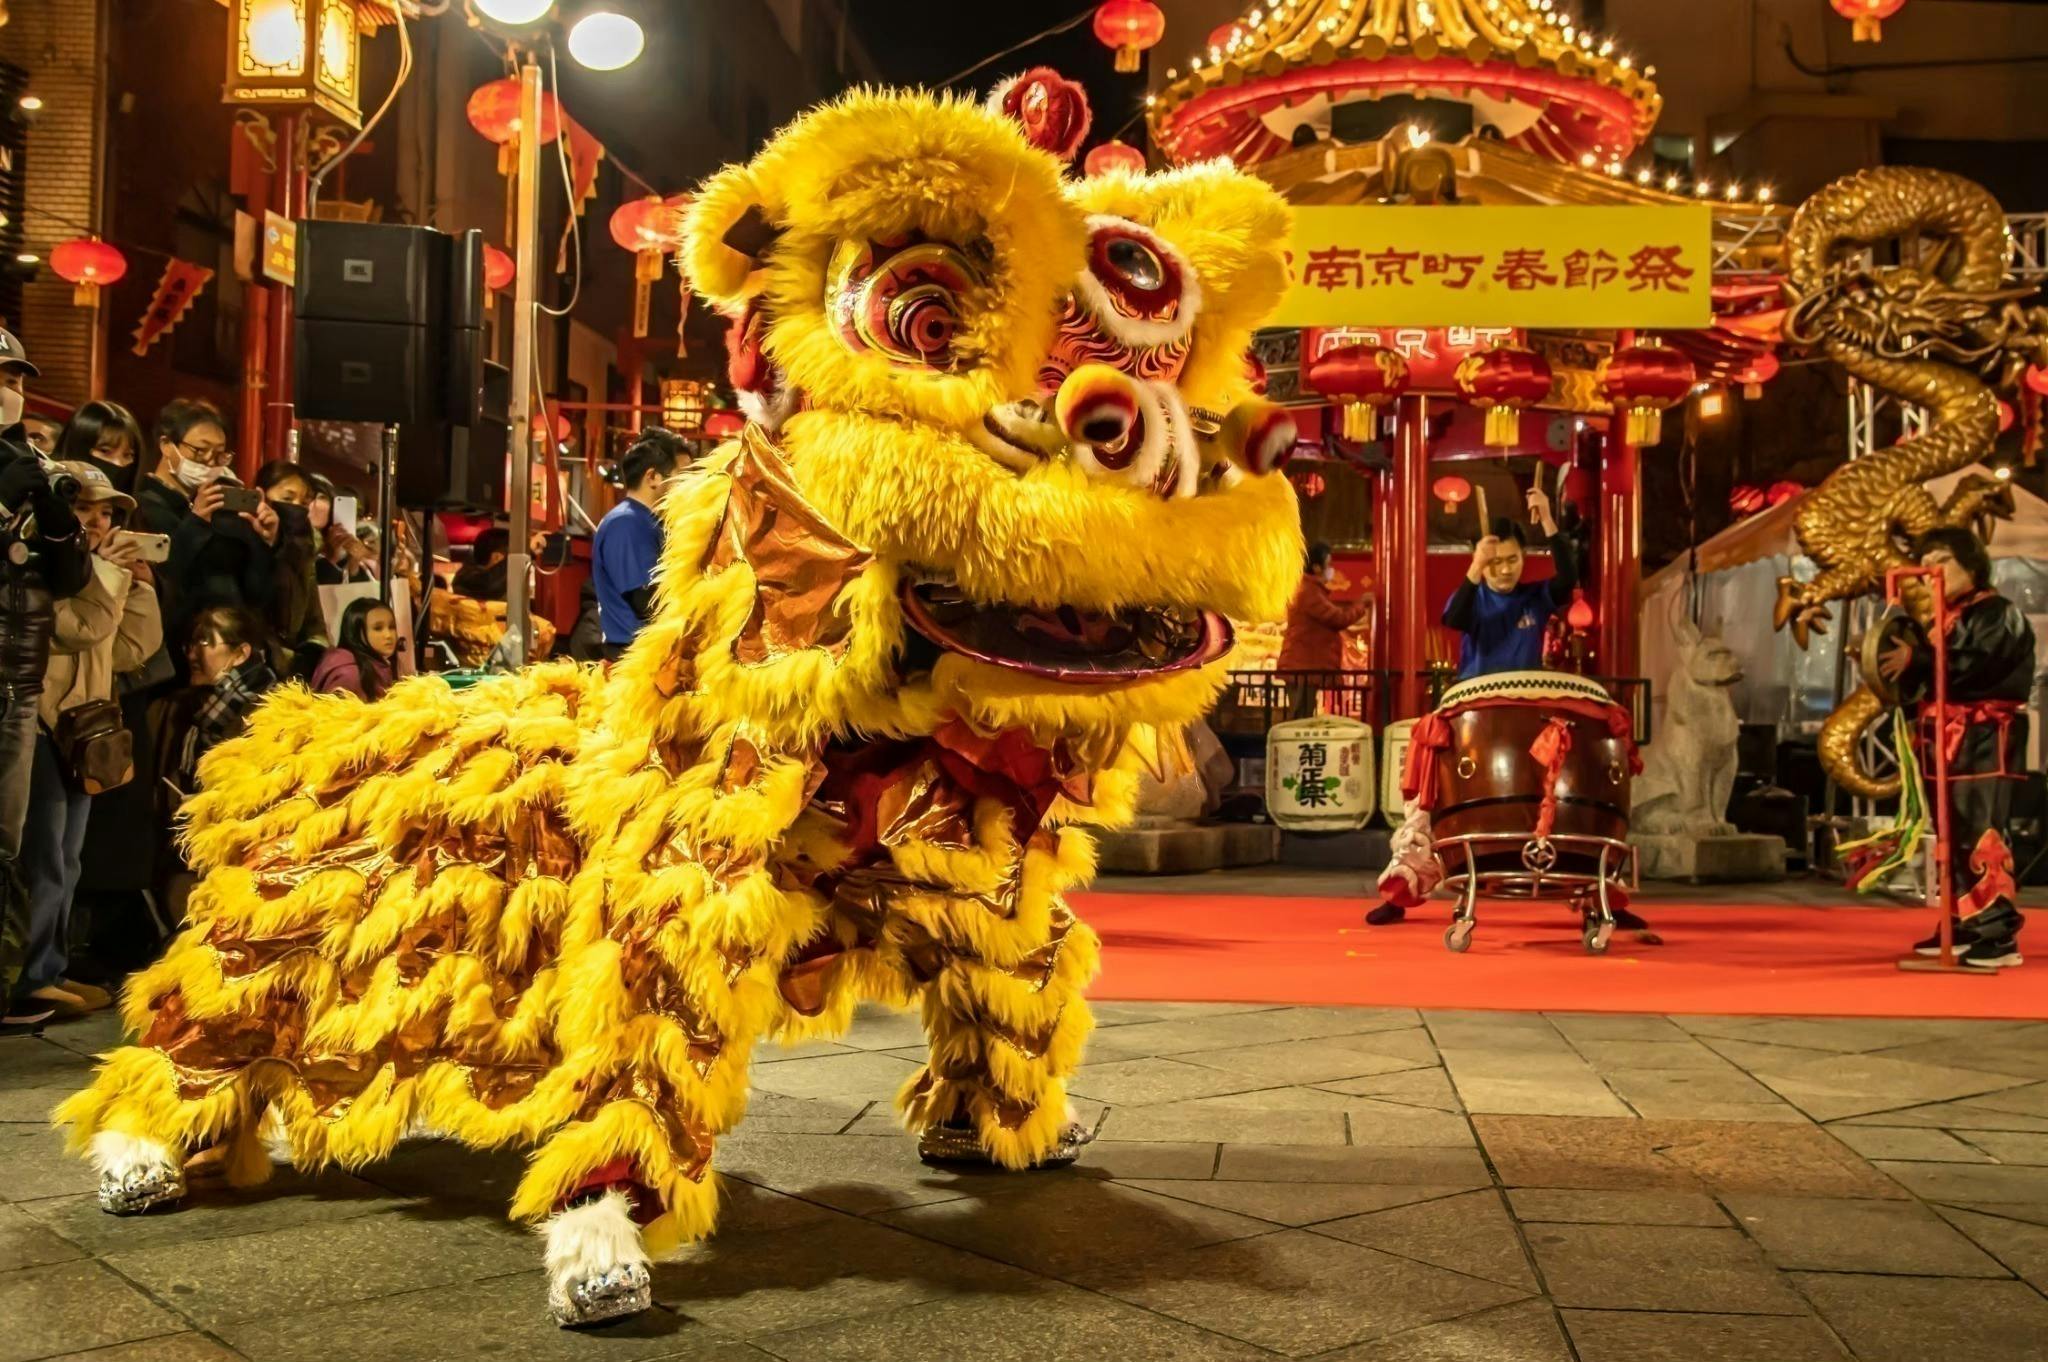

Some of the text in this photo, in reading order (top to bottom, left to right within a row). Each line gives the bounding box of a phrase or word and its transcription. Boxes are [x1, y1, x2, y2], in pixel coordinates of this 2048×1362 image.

[1284, 245, 1694, 293] 南京町春節祭
